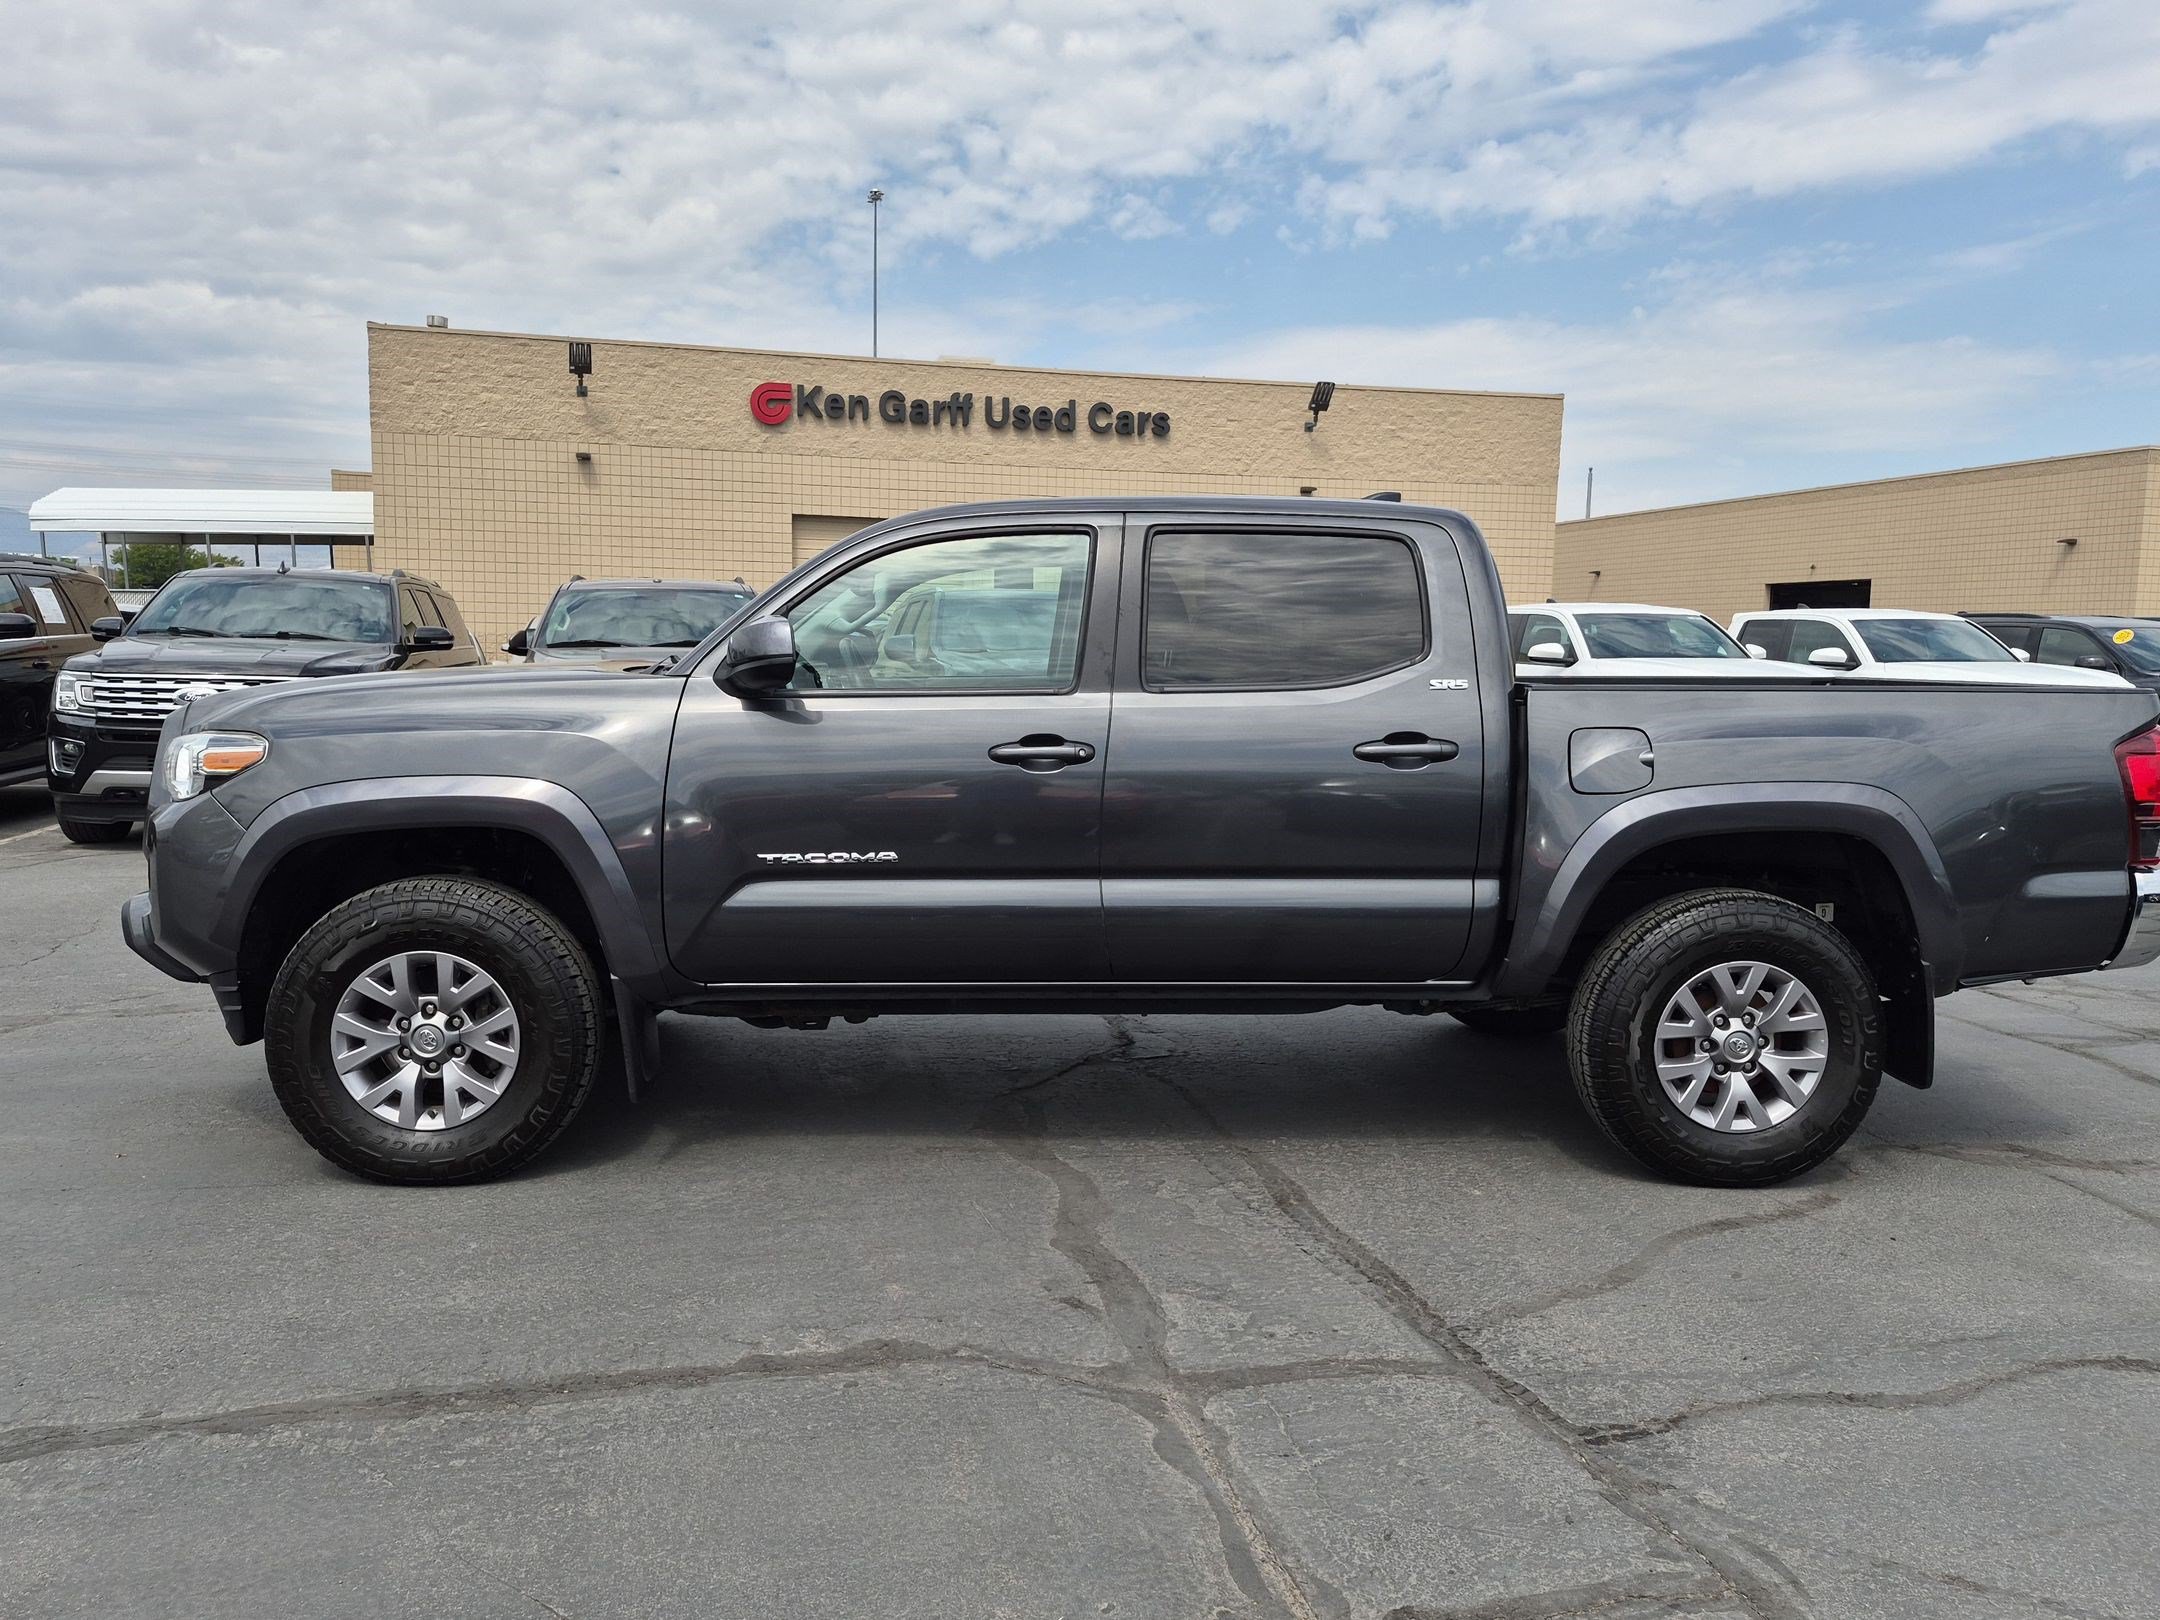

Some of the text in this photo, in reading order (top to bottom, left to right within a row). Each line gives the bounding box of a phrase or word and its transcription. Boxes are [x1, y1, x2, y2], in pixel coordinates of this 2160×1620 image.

[797, 384, 1171, 437] Ken Garff Used Cars
[1429, 679, 1469, 690] SR5
[757, 851, 899, 865] TACOMA
